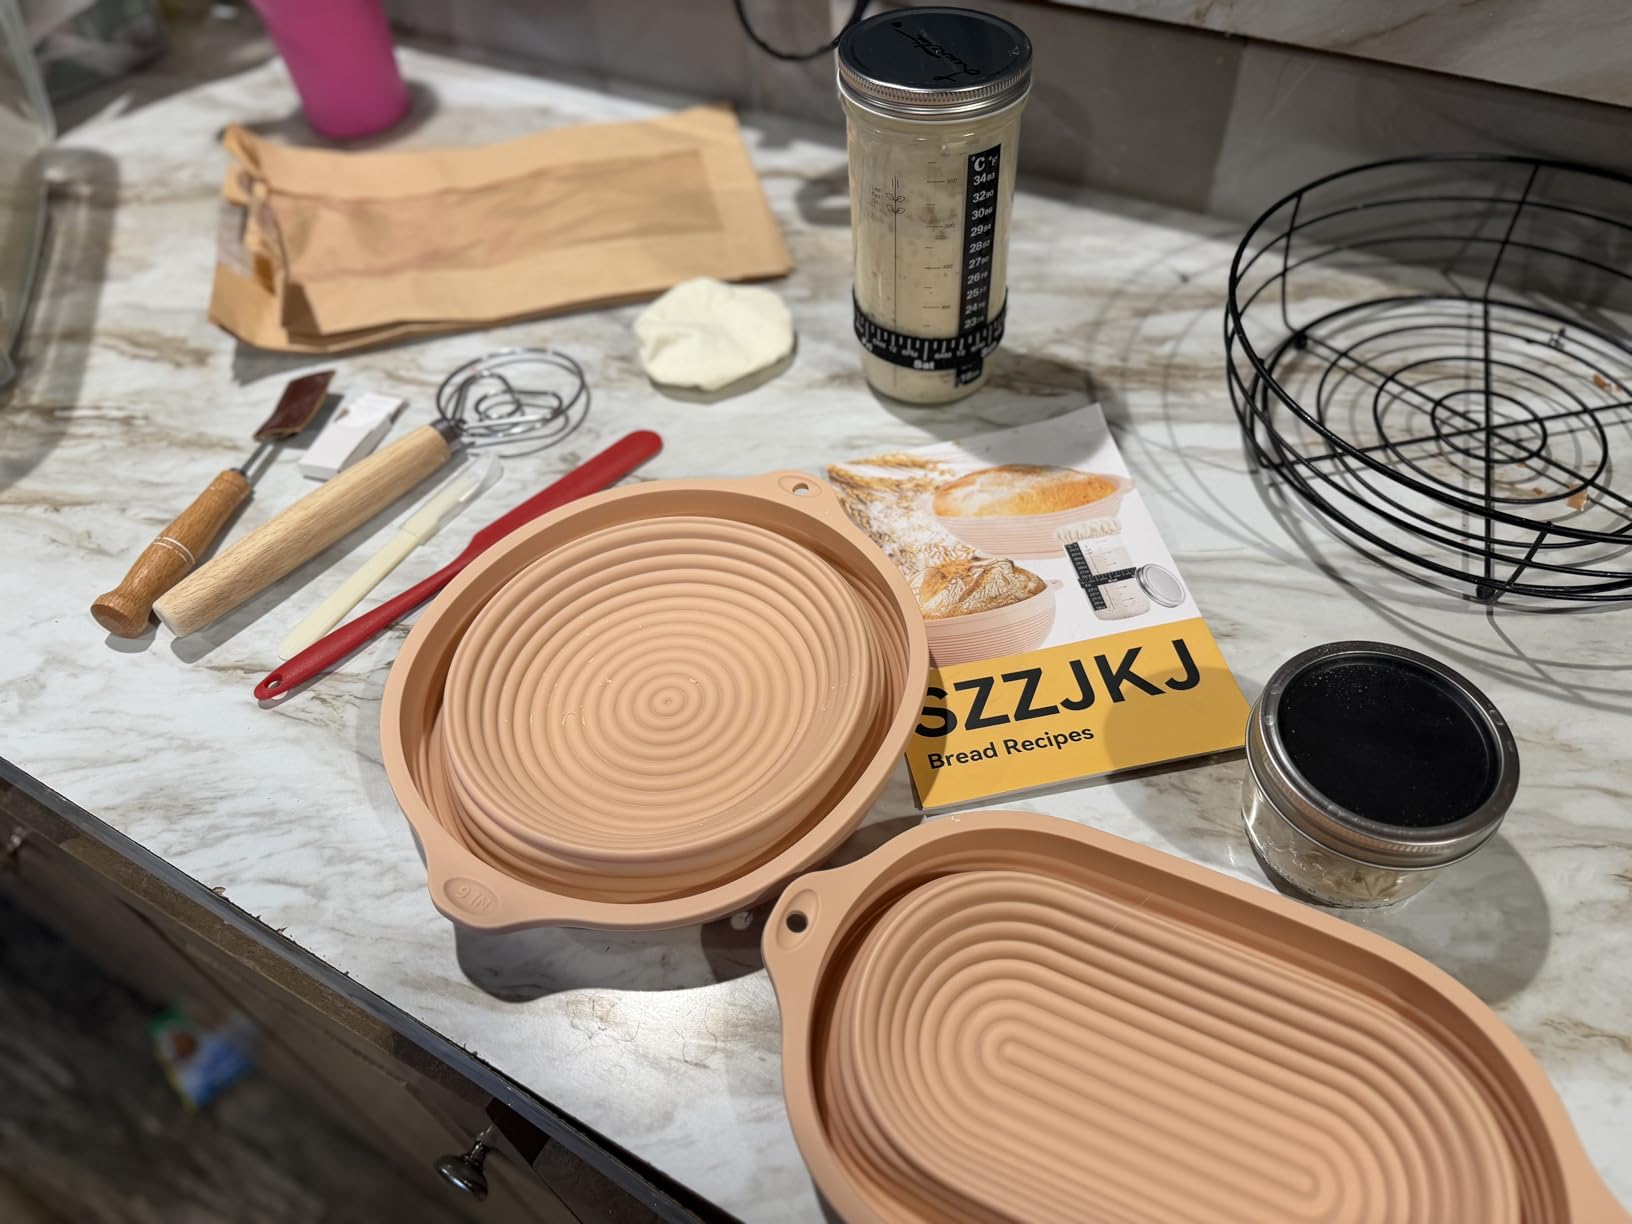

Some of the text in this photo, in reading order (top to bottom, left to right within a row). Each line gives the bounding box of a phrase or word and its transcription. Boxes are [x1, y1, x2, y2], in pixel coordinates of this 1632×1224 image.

[914, 638, 1200, 738] SZZJKJ
[927, 727, 1095, 770] Bread Recipes
